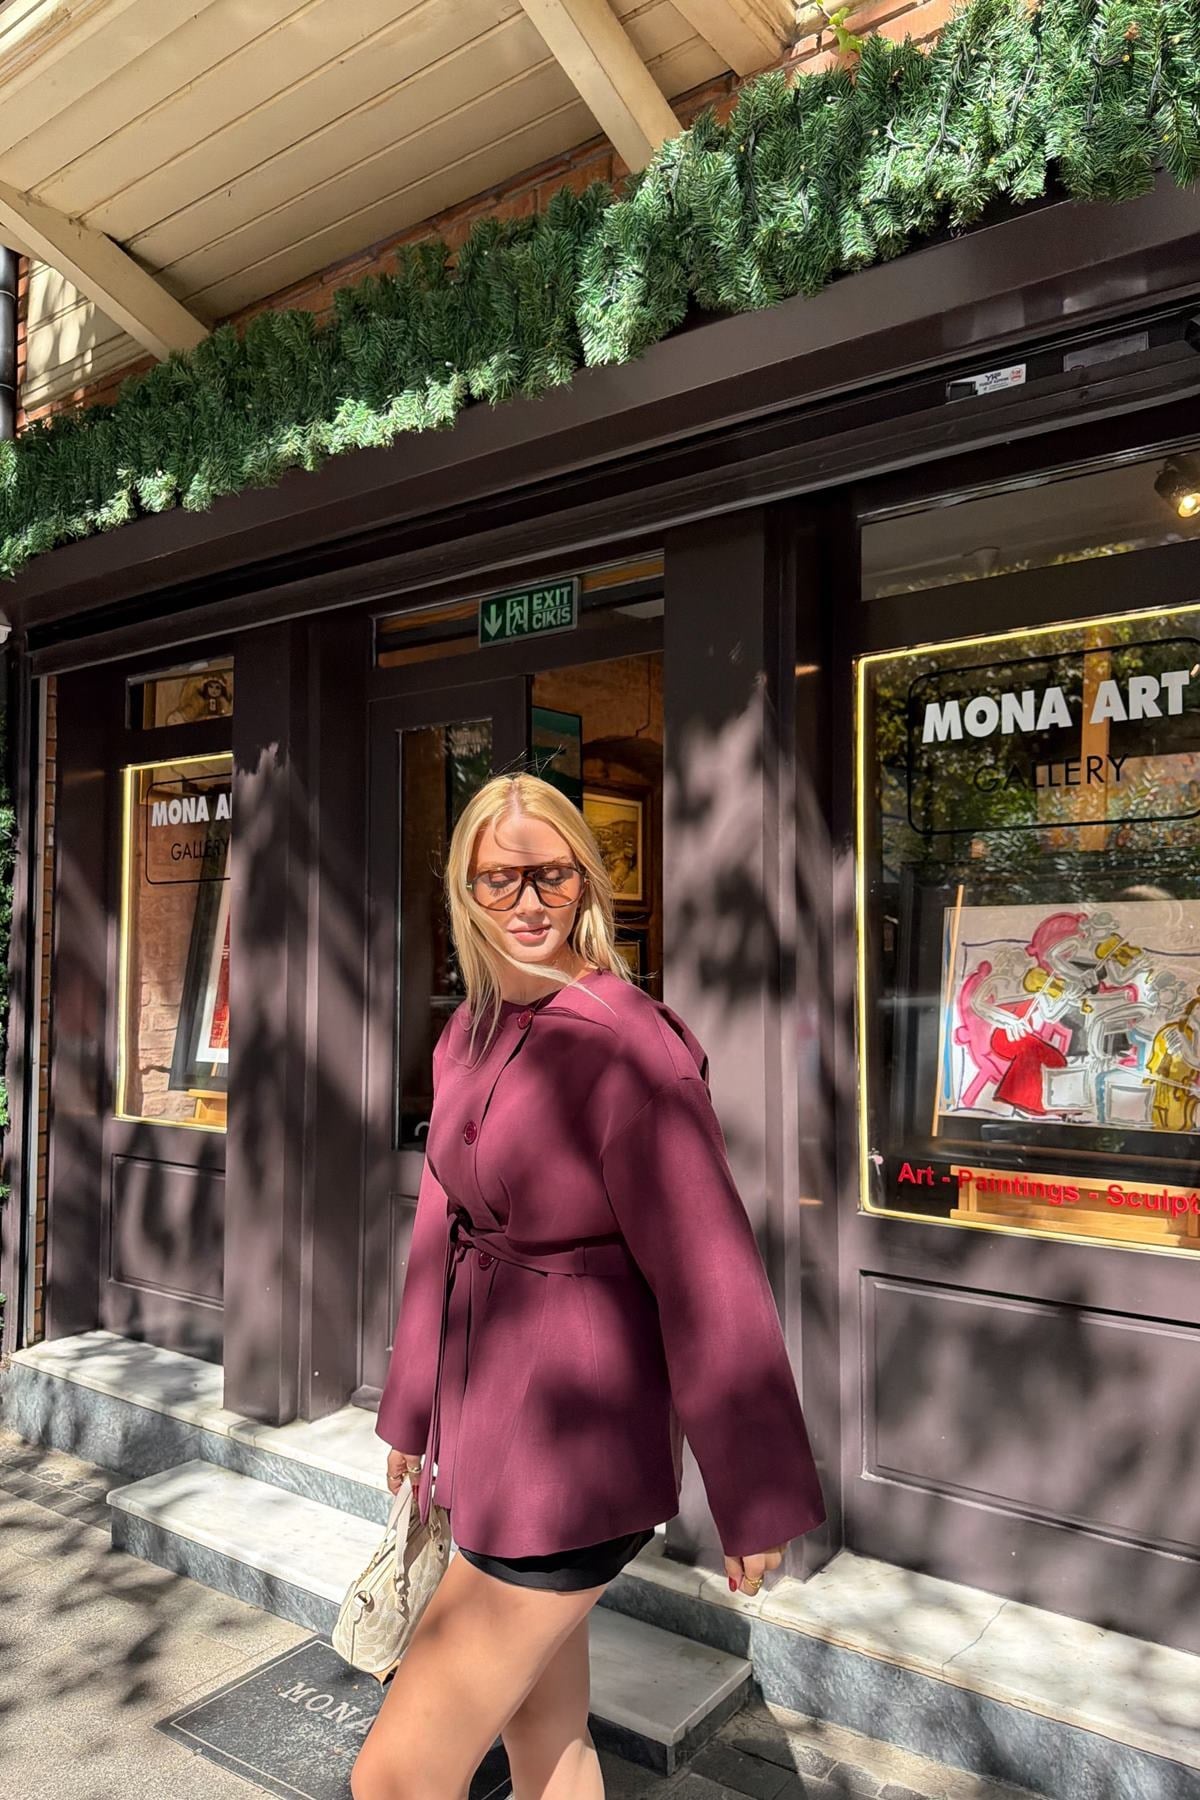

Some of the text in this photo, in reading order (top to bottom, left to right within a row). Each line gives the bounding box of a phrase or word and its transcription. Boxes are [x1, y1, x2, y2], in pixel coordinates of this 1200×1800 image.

[532, 586, 572, 611] EXIT
[922, 669, 1190, 744] MONA ART
[973, 753, 1129, 793] GALLERY
[152, 792, 232, 827] MONA A
[898, 1162, 935, 1186] Art
[957, 1169, 1080, 1206] Paintings
[278, 1682, 377, 1735] MONA
